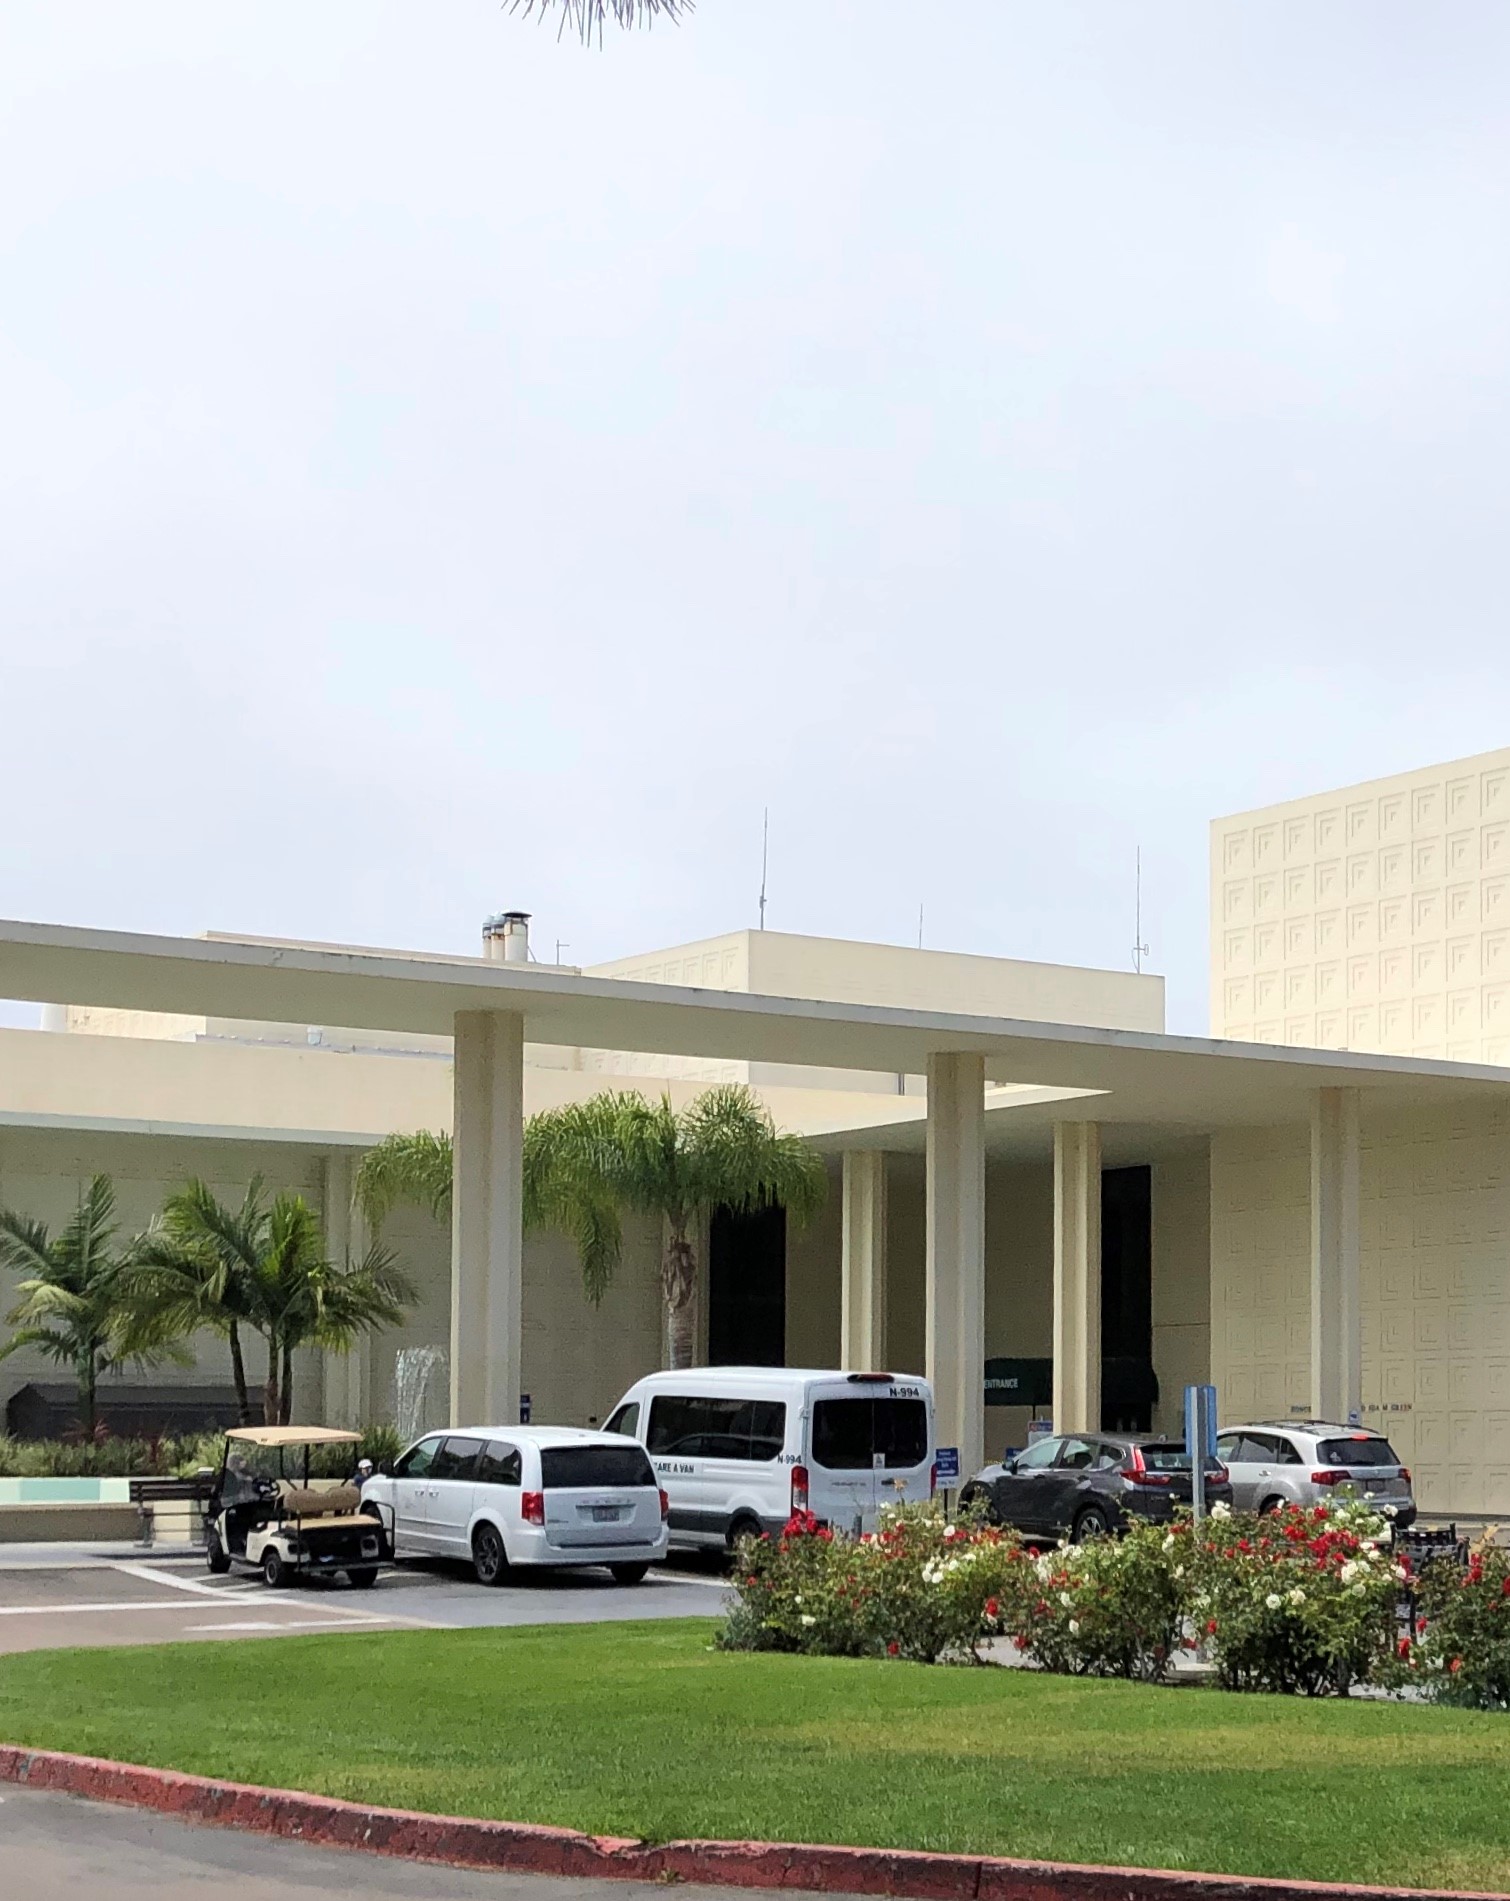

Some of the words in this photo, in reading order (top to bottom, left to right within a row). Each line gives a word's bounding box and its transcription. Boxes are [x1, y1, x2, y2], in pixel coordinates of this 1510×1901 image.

[984, 1378, 1018, 1389] ENTRANCE
[889, 1387, 920, 1398] N-994
[777, 1454, 802, 1464] N-994
[680, 1463, 694, 1474] VAN
